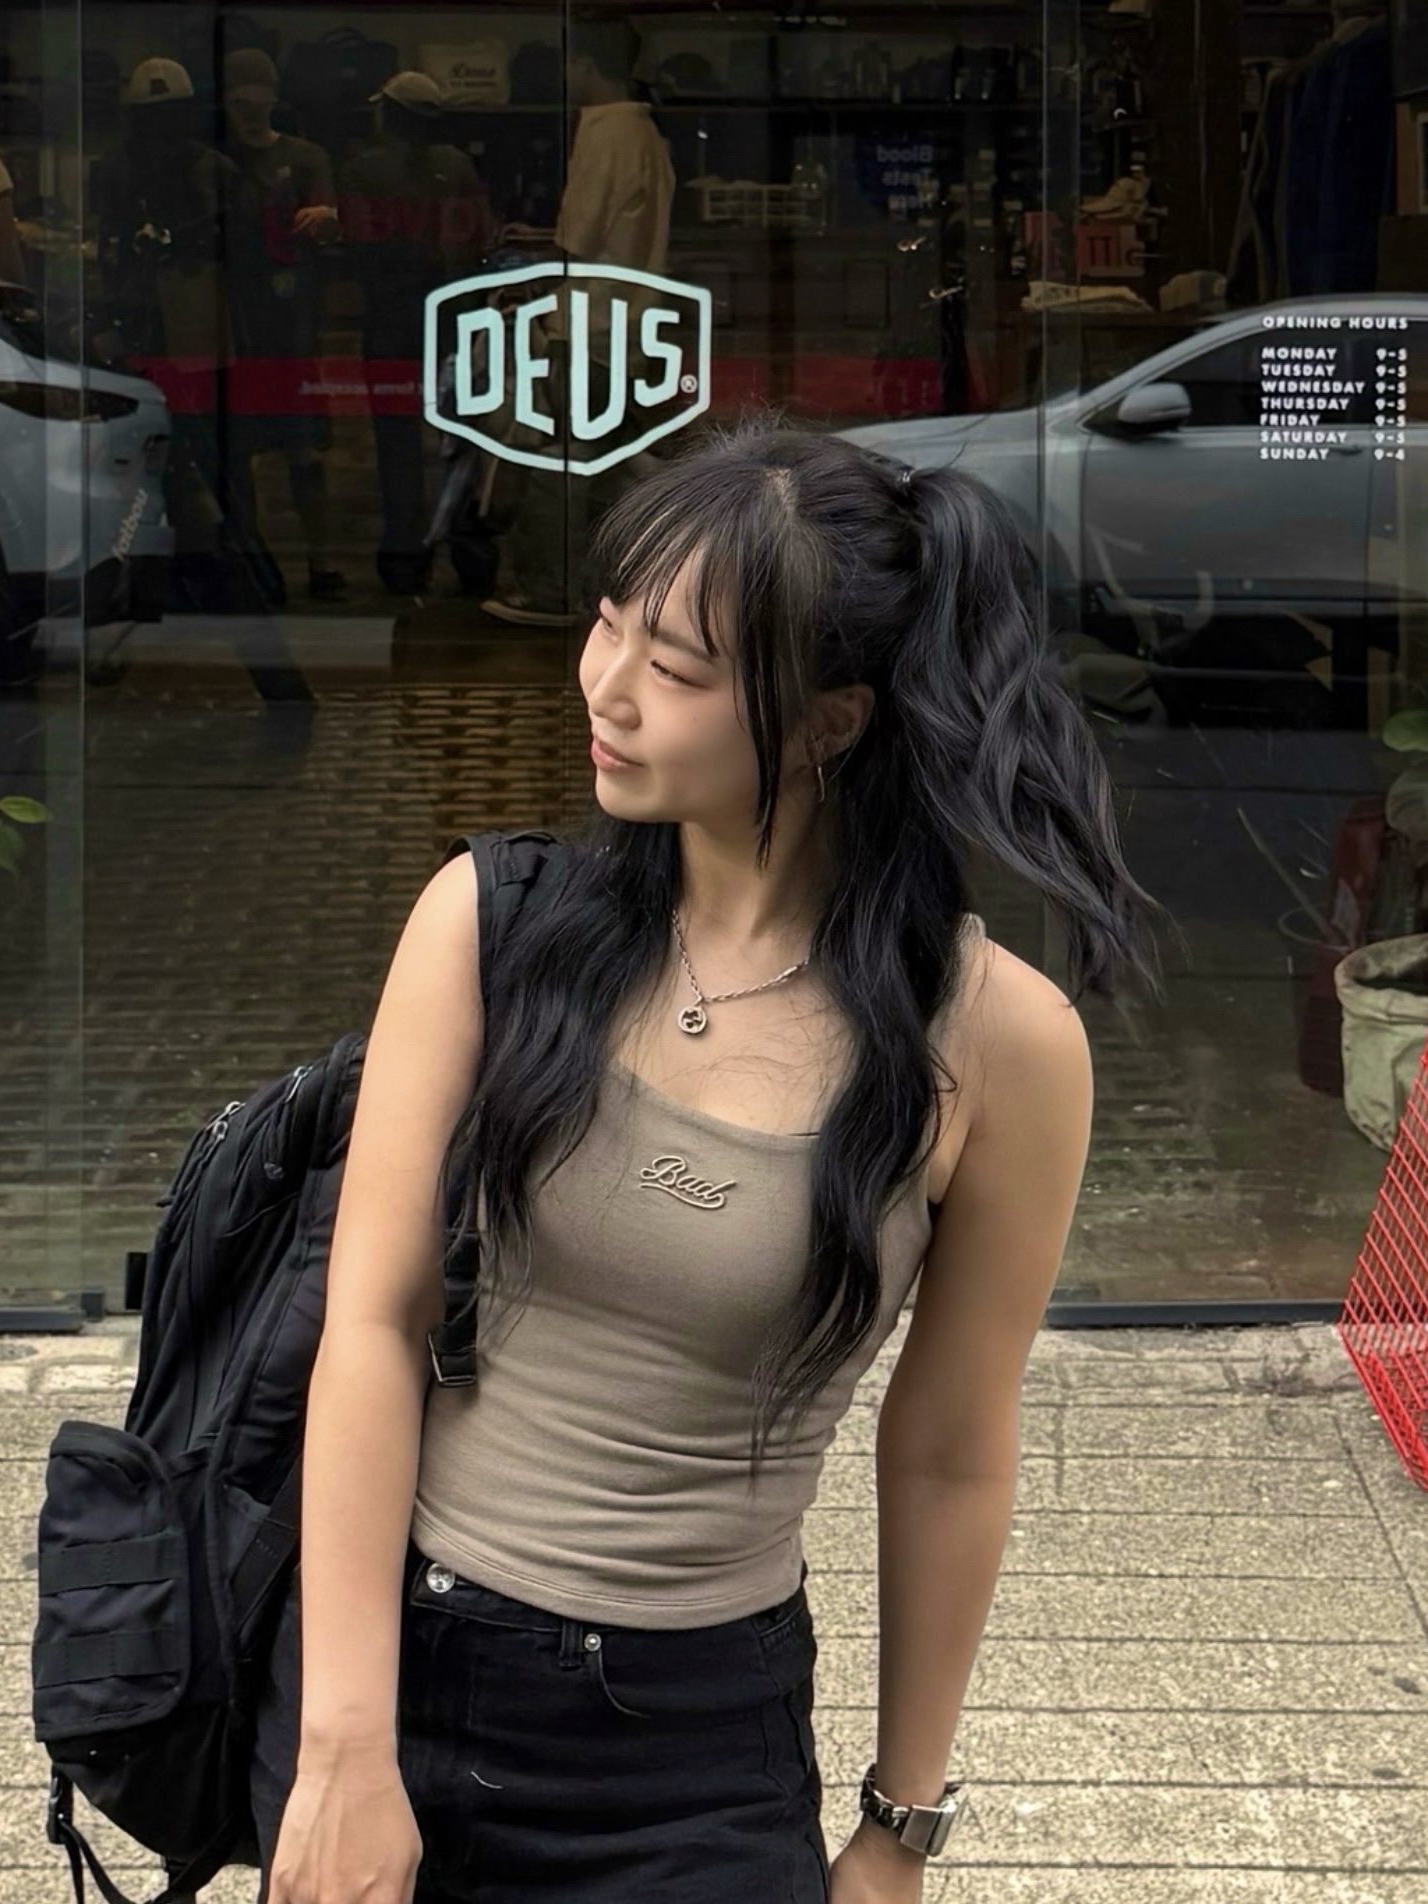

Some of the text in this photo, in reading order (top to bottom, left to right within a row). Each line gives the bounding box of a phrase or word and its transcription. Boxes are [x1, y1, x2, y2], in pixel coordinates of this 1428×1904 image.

[1262, 316, 1408, 329] OPENING HOURS
[1261, 347, 1337, 360] MONDAY
[455, 289, 683, 441] DEUS
[1260, 364, 1336, 377] TUESDAY
[1260, 381, 1365, 393] WEDNESDAY
[1260, 397, 1350, 410] THURSDAY
[1259, 414, 1321, 426] FRIDAY
[1259, 431, 1347, 443] SATURDAY
[1259, 448, 1329, 460] SUNDAY
